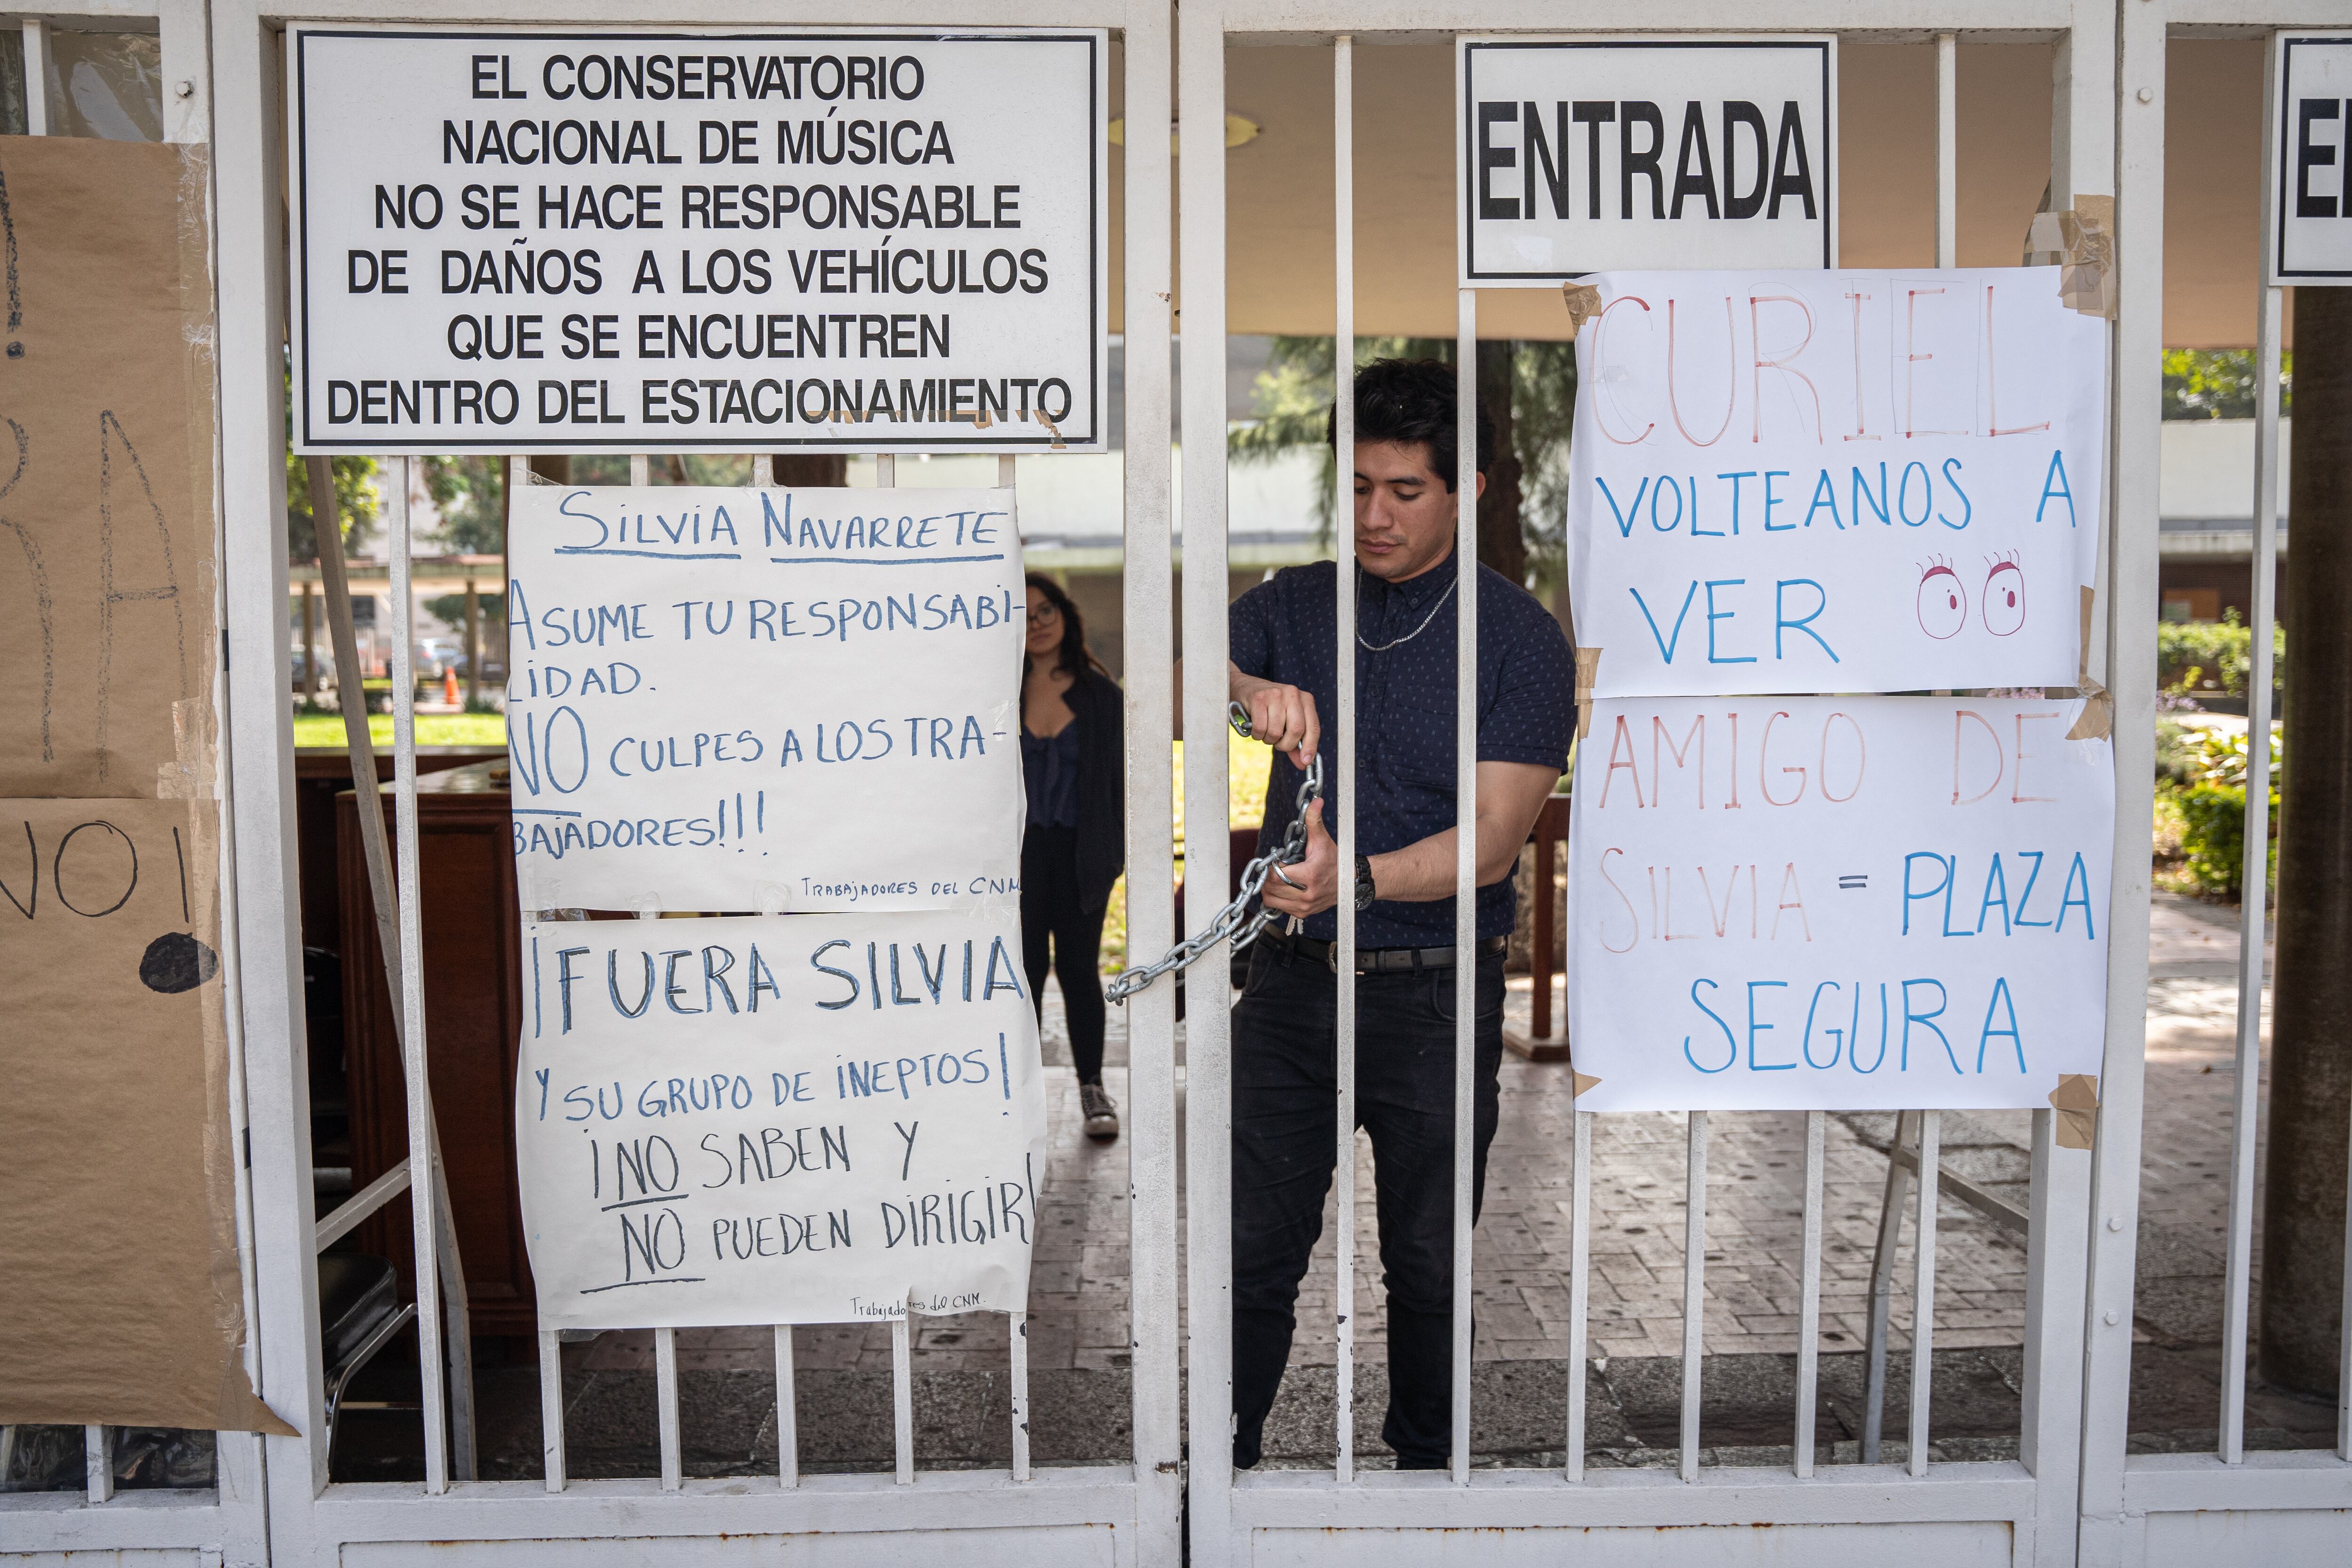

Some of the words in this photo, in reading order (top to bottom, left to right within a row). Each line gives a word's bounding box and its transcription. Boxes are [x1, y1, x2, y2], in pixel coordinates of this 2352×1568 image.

[472, 55, 526, 99] EL
[543, 55, 924, 100] CONSERVATORIO
[444, 120, 682, 165] NACIONAL
[699, 121, 758, 164] DE
[778, 106, 954, 165] MÚSICA
[1478, 101, 1817, 219] ENTRADA
[2296, 99, 2352, 217] E
[376, 184, 443, 229] NO
[461, 184, 519, 230] SE
[539, 184, 663, 230] HACE
[683, 184, 1020, 229] RESPONSABLE
[349, 250, 408, 294] DE
[442, 237, 602, 294] DAÑOS
[632, 250, 665, 293] A
[683, 249, 771, 294] LOS
[788, 235, 1048, 294] VEHÍCULOS
[448, 314, 543, 361] QUE
[562, 314, 619, 359] SE
[639, 314, 949, 359] ENCUENTREN
[1591, 280, 2050, 446] CURIEL
[328, 380, 519, 424] DENTRO
[539, 380, 625, 423] DEL
[643, 378, 1071, 424] ESTACIONAMIENTO
[1596, 458, 1971, 537] VOLTEANOS
[2036, 450, 2075, 527] A
[1629, 579, 1839, 664] VER
[509, 706, 589, 796] NO
[610, 730, 763, 776] CULPES
[1599, 711, 1866, 810] AMIGO
[1951, 711, 2060, 805] DE
[932, 881, 958, 895] DEL
[1600, 848, 1812, 953] SILVIA
[1902, 852, 2094, 939] PLAZA
[810, 936, 1024, 1011] SILVIA
[1684, 977, 2026, 1075] SEGURA
[536, 1067, 549, 1121] Y
[565, 1084, 622, 1121] SU
[638, 1074, 752, 1118] GRUPO
[774, 1072, 815, 1106] DE
[700, 1124, 850, 1189] SABEN
[894, 1121, 918, 1180] Y
[620, 1208, 684, 1282] NO
[713, 1209, 851, 1261] PUEDEN
